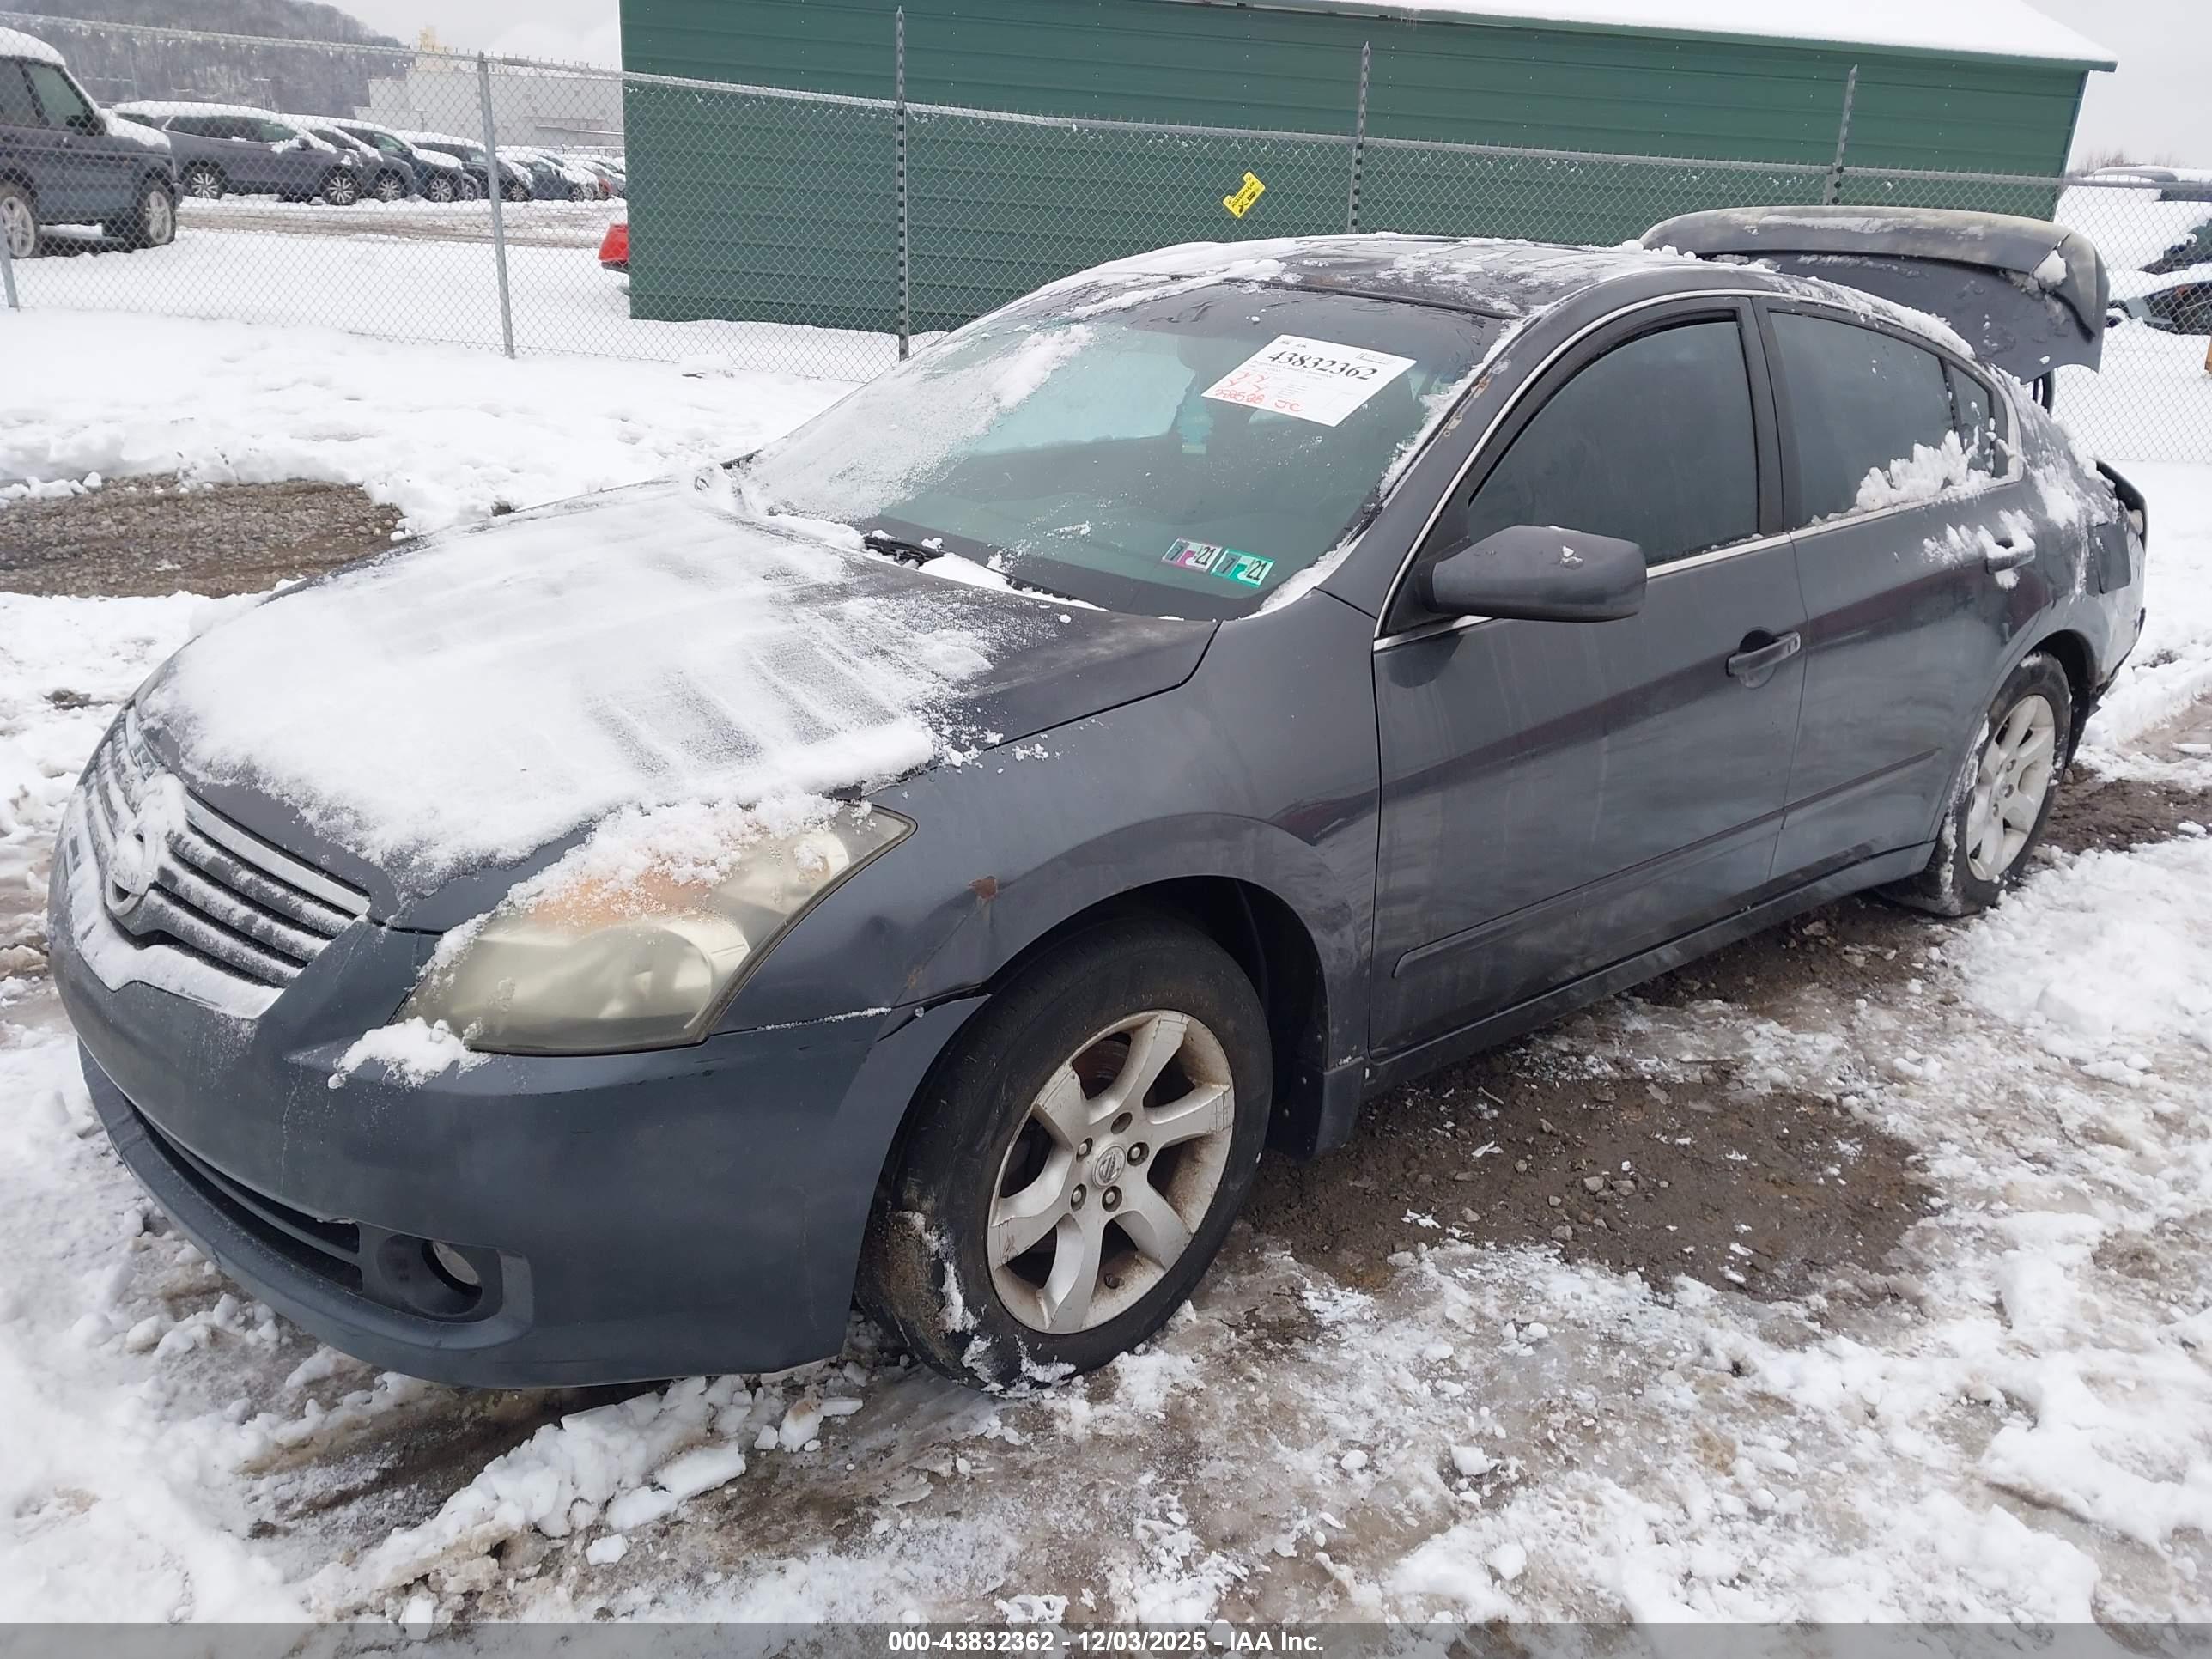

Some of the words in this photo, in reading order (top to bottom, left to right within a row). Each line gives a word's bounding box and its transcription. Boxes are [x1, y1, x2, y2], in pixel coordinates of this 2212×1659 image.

[1267, 349, 1378, 380] 43832362
[1194, 546, 1217, 567] 21
[1222, 558, 1235, 573] 7
[1246, 560, 1268, 581] 21
